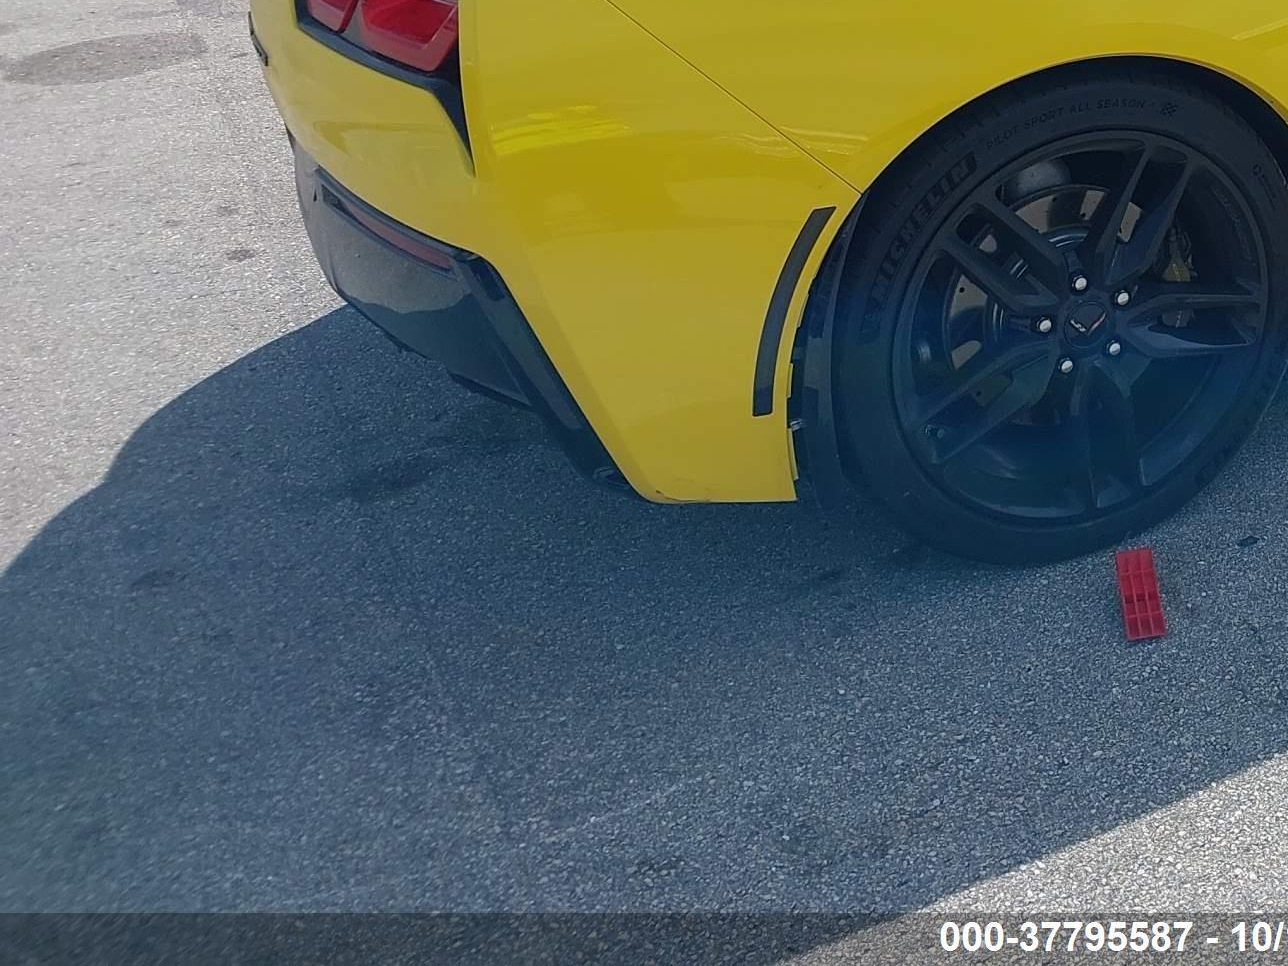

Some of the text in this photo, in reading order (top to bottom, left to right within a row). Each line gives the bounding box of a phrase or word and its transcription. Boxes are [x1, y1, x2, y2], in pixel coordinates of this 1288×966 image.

[985, 124, 1019, 149] PILOT
[1024, 106, 1065, 130] SPORT
[1070, 102, 1091, 115] ALL
[1096, 97, 1146, 110] SEASON
